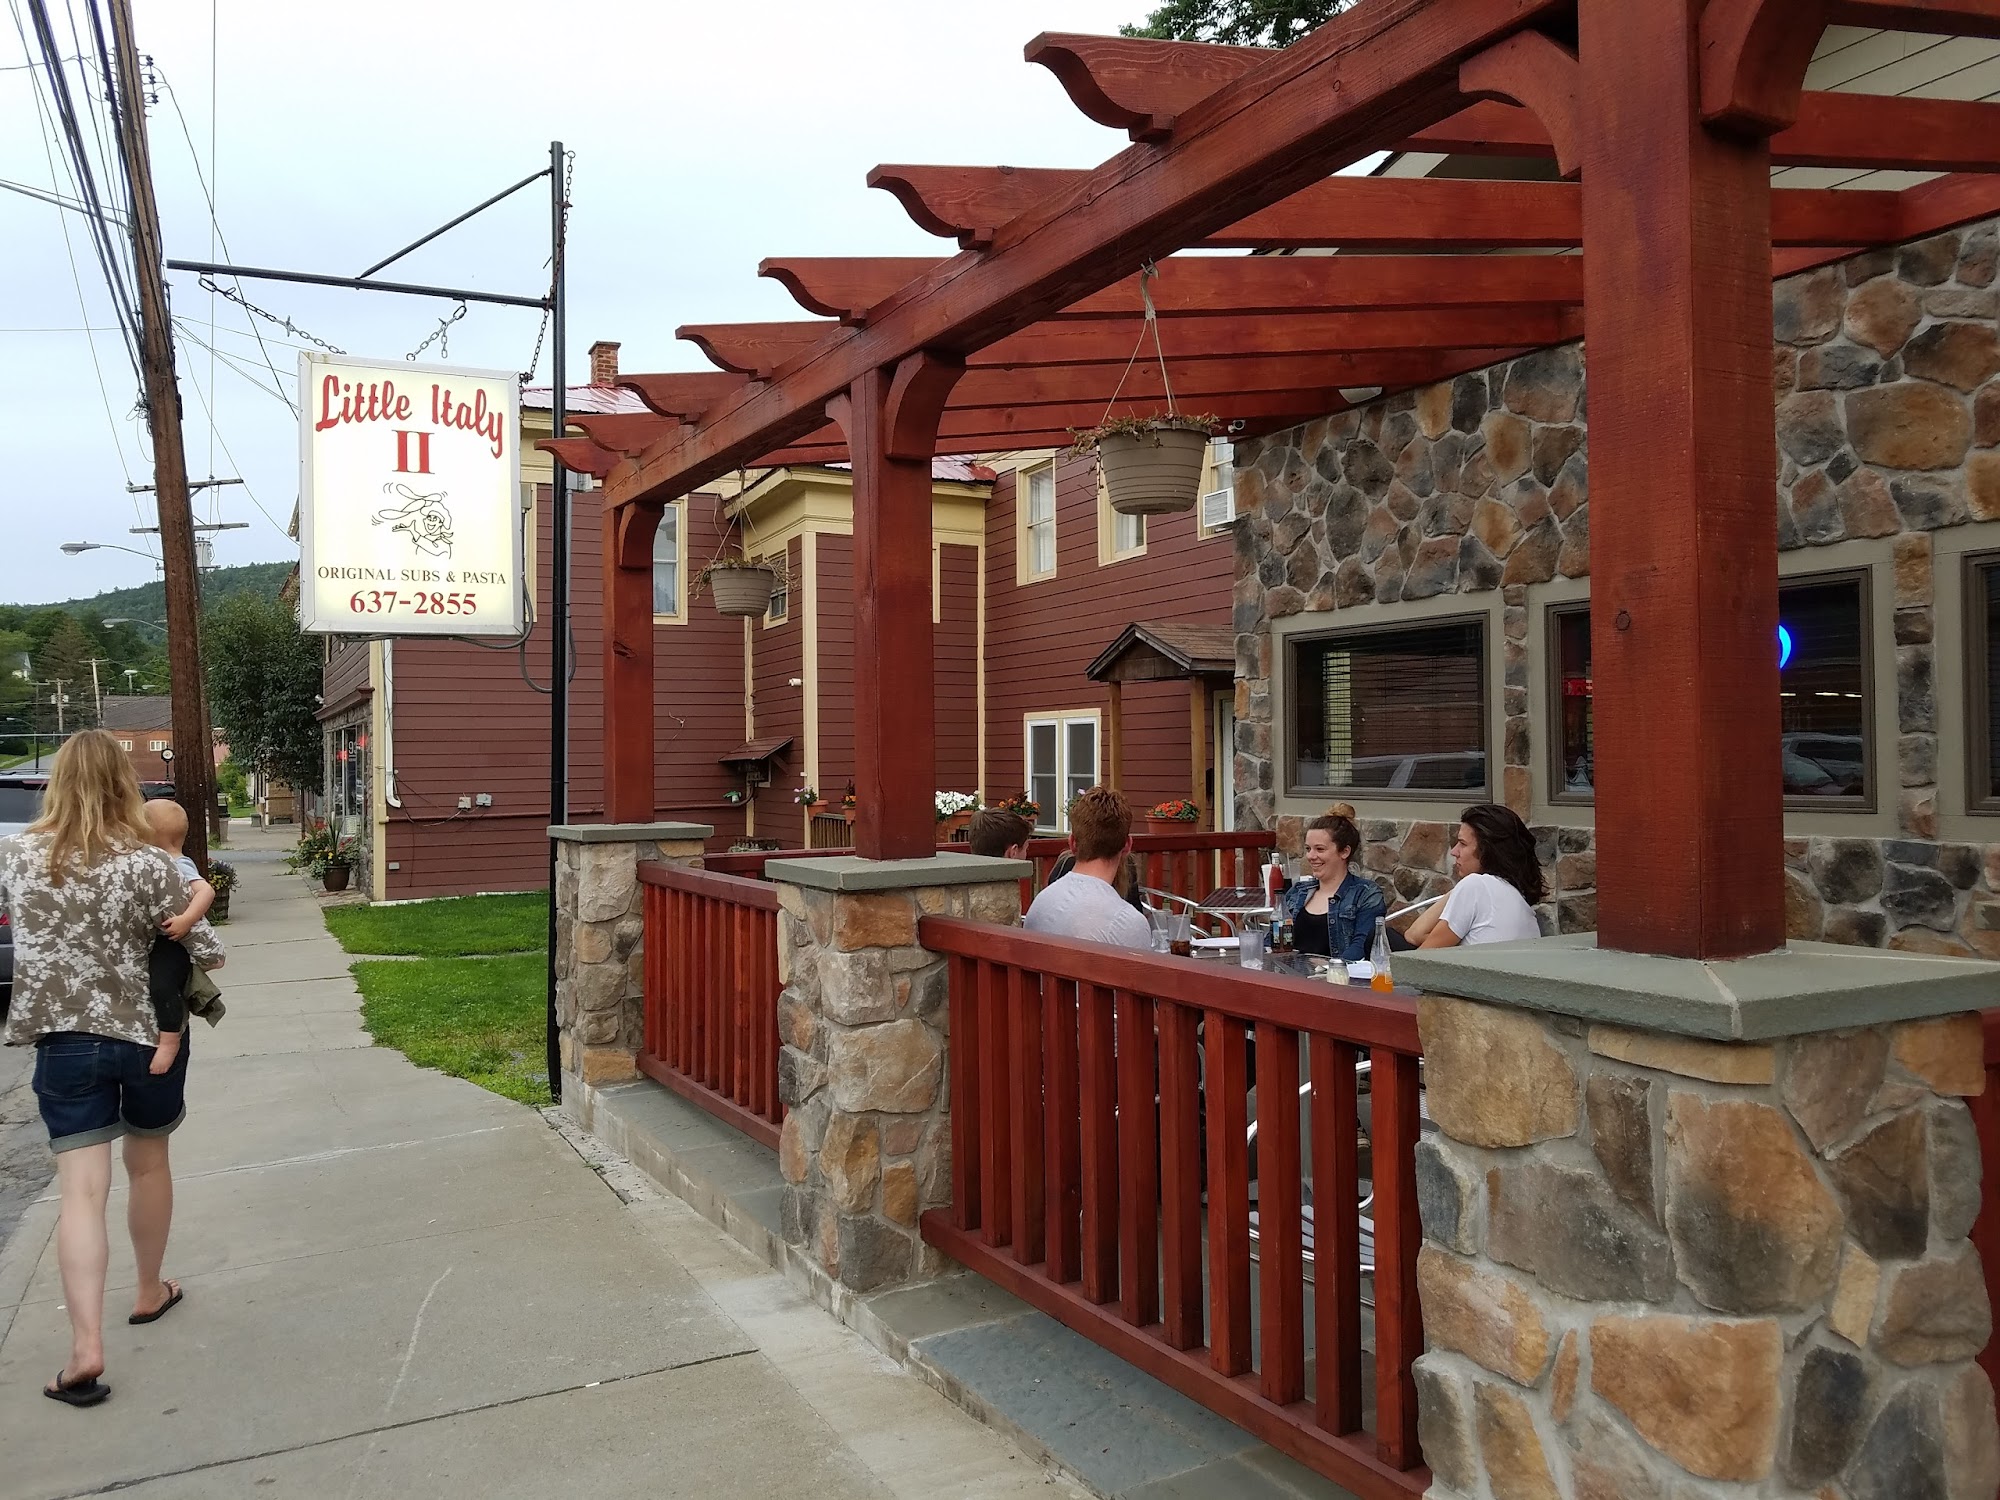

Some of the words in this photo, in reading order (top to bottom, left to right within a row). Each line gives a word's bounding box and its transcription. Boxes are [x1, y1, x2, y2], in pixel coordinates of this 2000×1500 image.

[315, 374, 413, 432] Little
[431, 384, 503, 459] Italy
[391, 429, 435, 474] II
[318, 566, 396, 581] ORIGINAL
[401, 569, 441, 583] SUBS
[446, 571, 456, 583] &
[462, 571, 507, 585] PASTA
[350, 590, 477, 616] 637-2855
